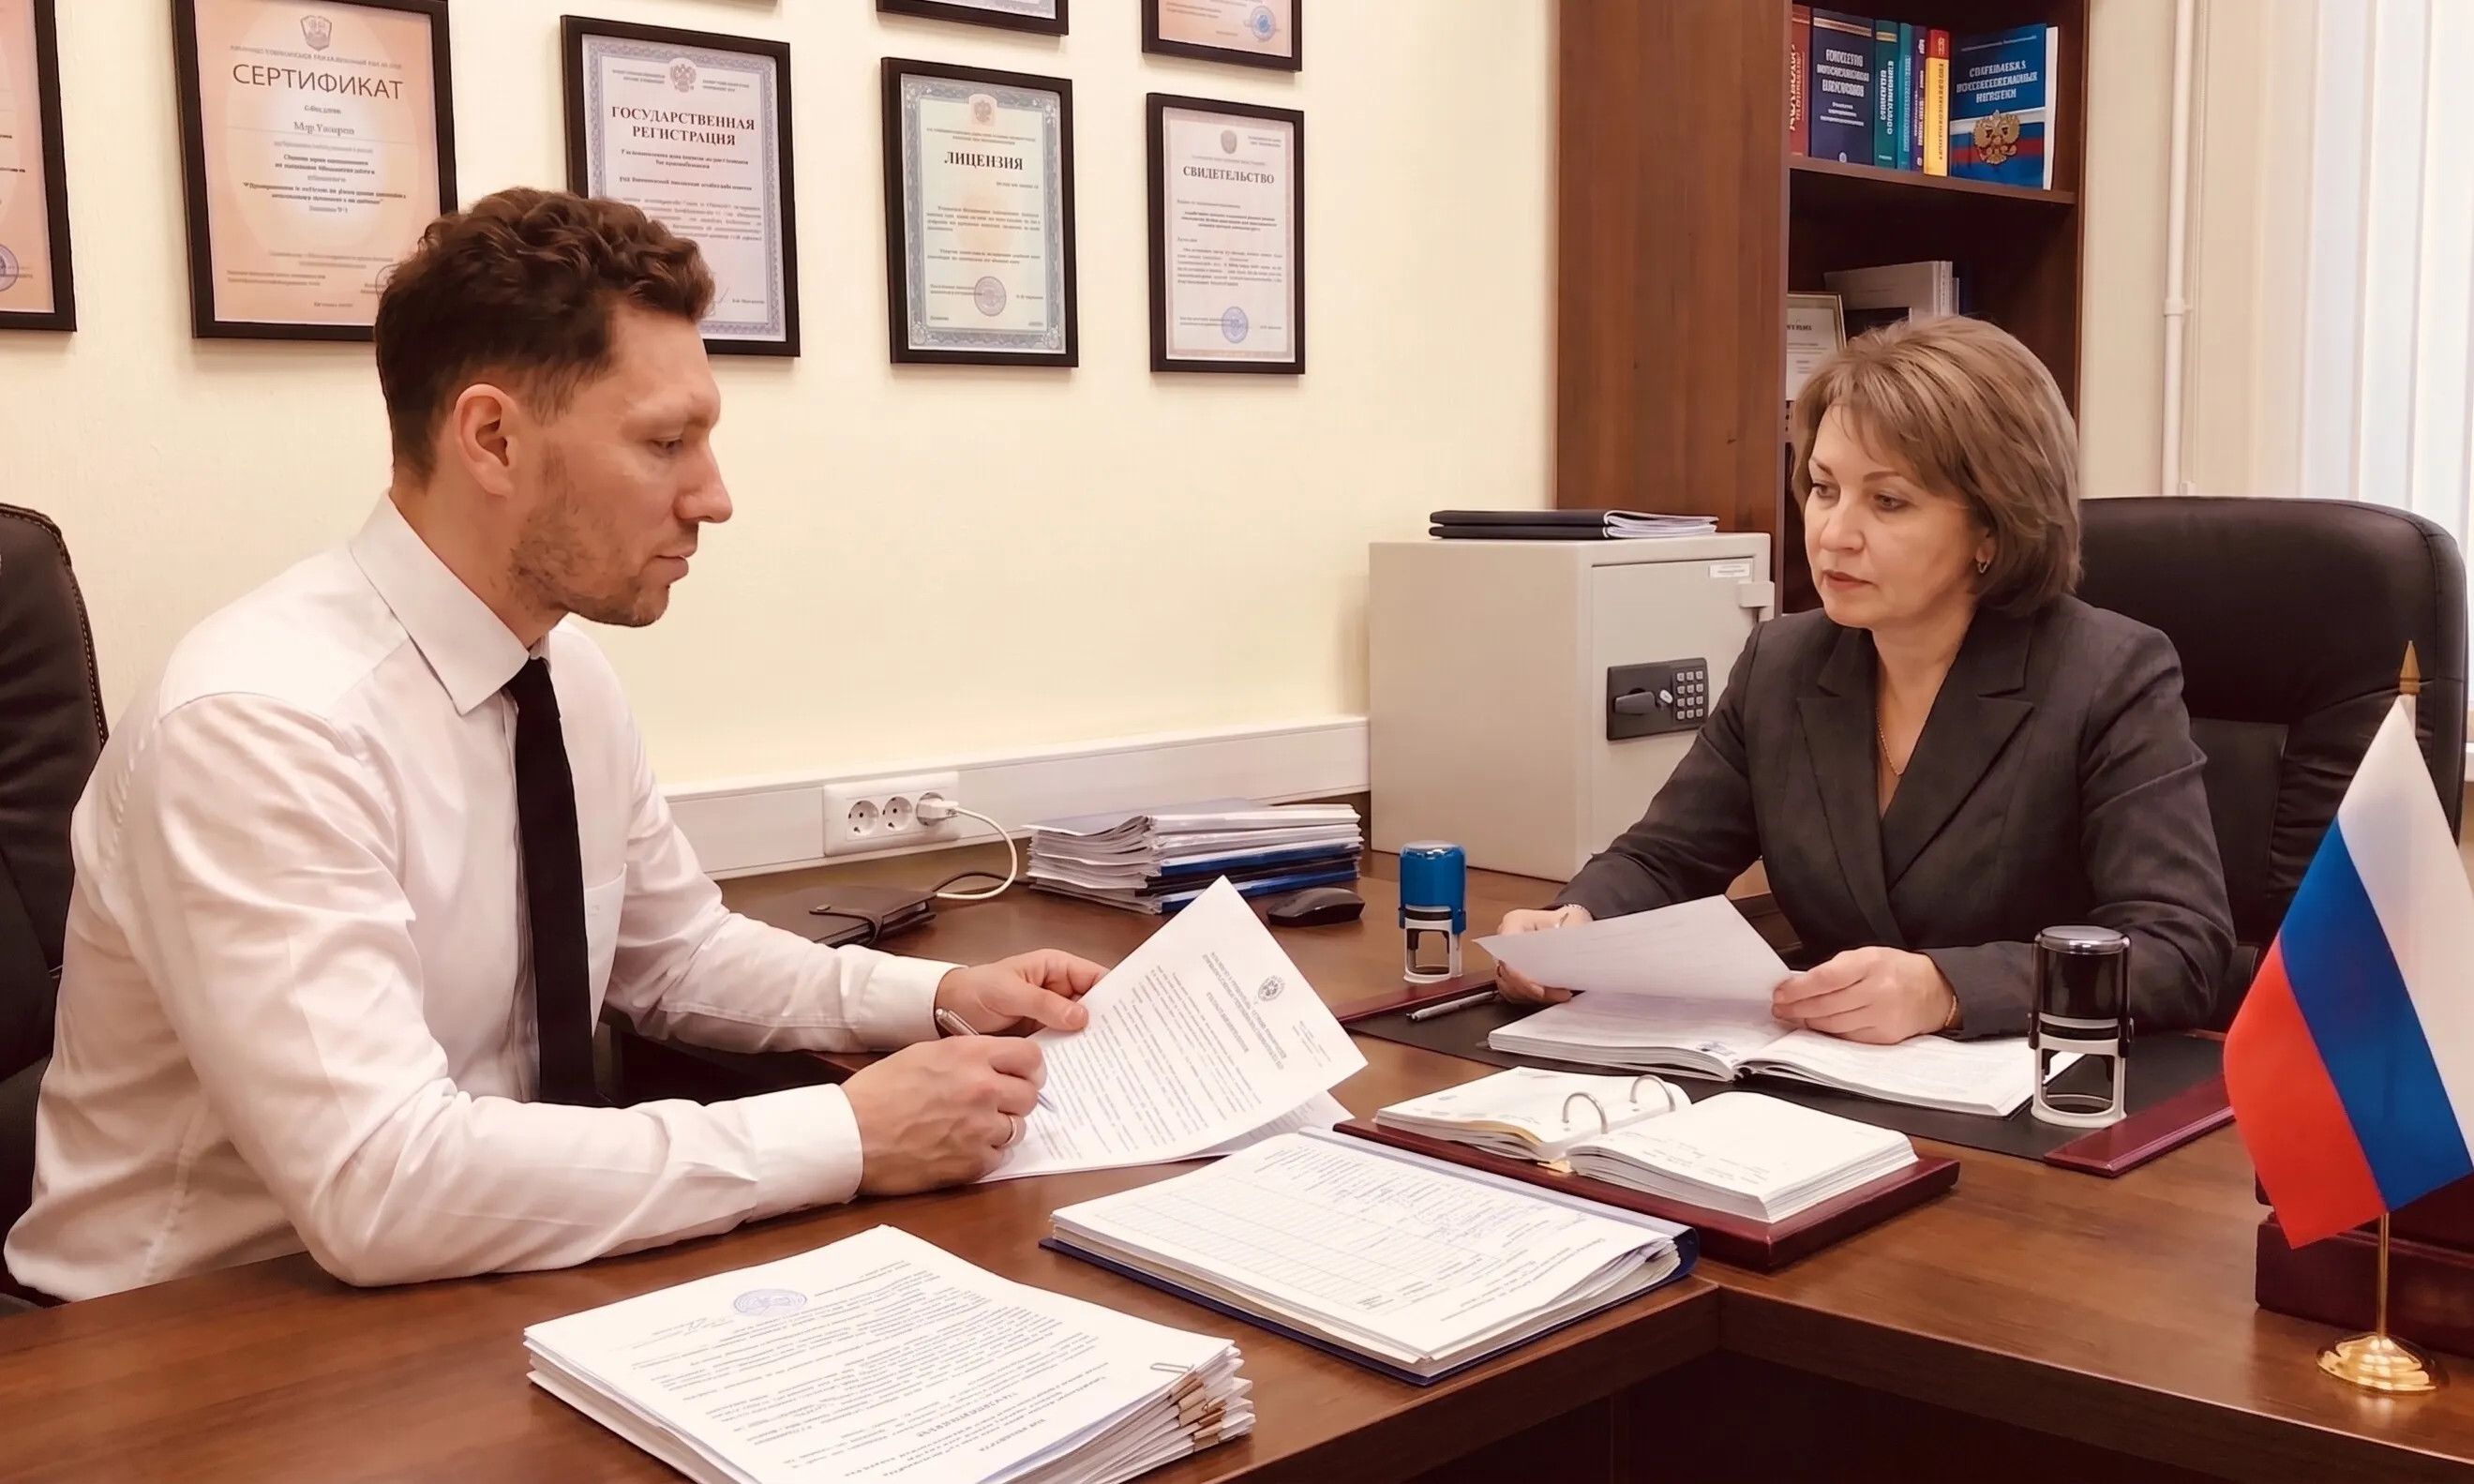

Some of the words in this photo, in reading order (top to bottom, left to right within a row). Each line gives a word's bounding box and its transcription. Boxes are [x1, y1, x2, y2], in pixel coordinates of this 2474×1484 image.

[232, 63, 404, 99] СЕРТИФИКАТ
[611, 106, 756, 130] ГОСУДАРСТВЕННАЯ
[632, 126, 737, 146] РЕГИСТРАЦИЯ
[944, 151, 1024, 171] ЛИЦЕНЗИЯ
[1182, 165, 1275, 185] СВИДЕТЕЛЬСТВО
